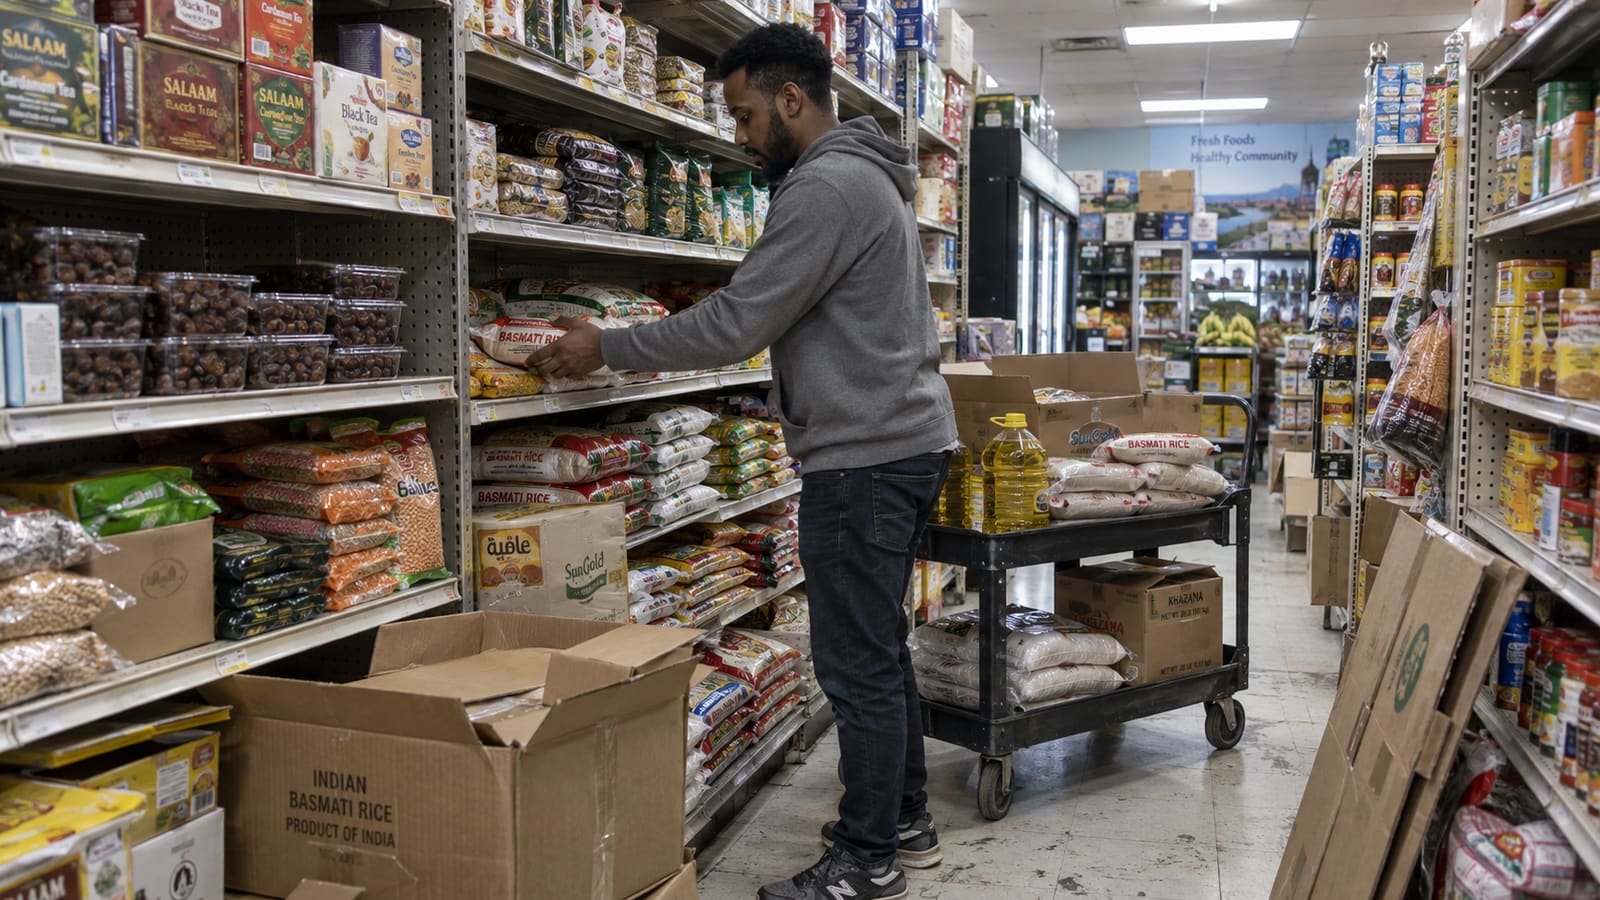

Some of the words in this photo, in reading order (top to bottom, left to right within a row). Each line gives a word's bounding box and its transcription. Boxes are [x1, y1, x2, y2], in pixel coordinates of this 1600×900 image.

[2, 28, 67, 59] SALAAM
[56, 81, 76, 98] Tea
[164, 76, 217, 103] SALAAM
[259, 87, 304, 111] SALAAM
[341, 103, 364, 123] Black
[365, 110, 378, 126] Tea
[1191, 135, 1221, 146] Fresh
[1223, 133, 1256, 146] Foods
[1191, 152, 1232, 164] Healthy
[1234, 150, 1298, 163] Community
[500, 331, 544, 345] BASMATI
[1128, 440, 1167, 449] BASMATI
[1168, 440, 1190, 449] RICE
[478, 492, 523, 503] BASMATI
[526, 493, 551, 504] RICE
[565, 552, 604, 580] SunGold
[313, 768, 367, 794] INDIAN
[289, 790, 353, 817] BASMATI
[359, 801, 393, 823] RICE
[286, 816, 339, 840] PRODUCT
[343, 826, 358, 842] OF
[361, 828, 396, 848] INDIA
